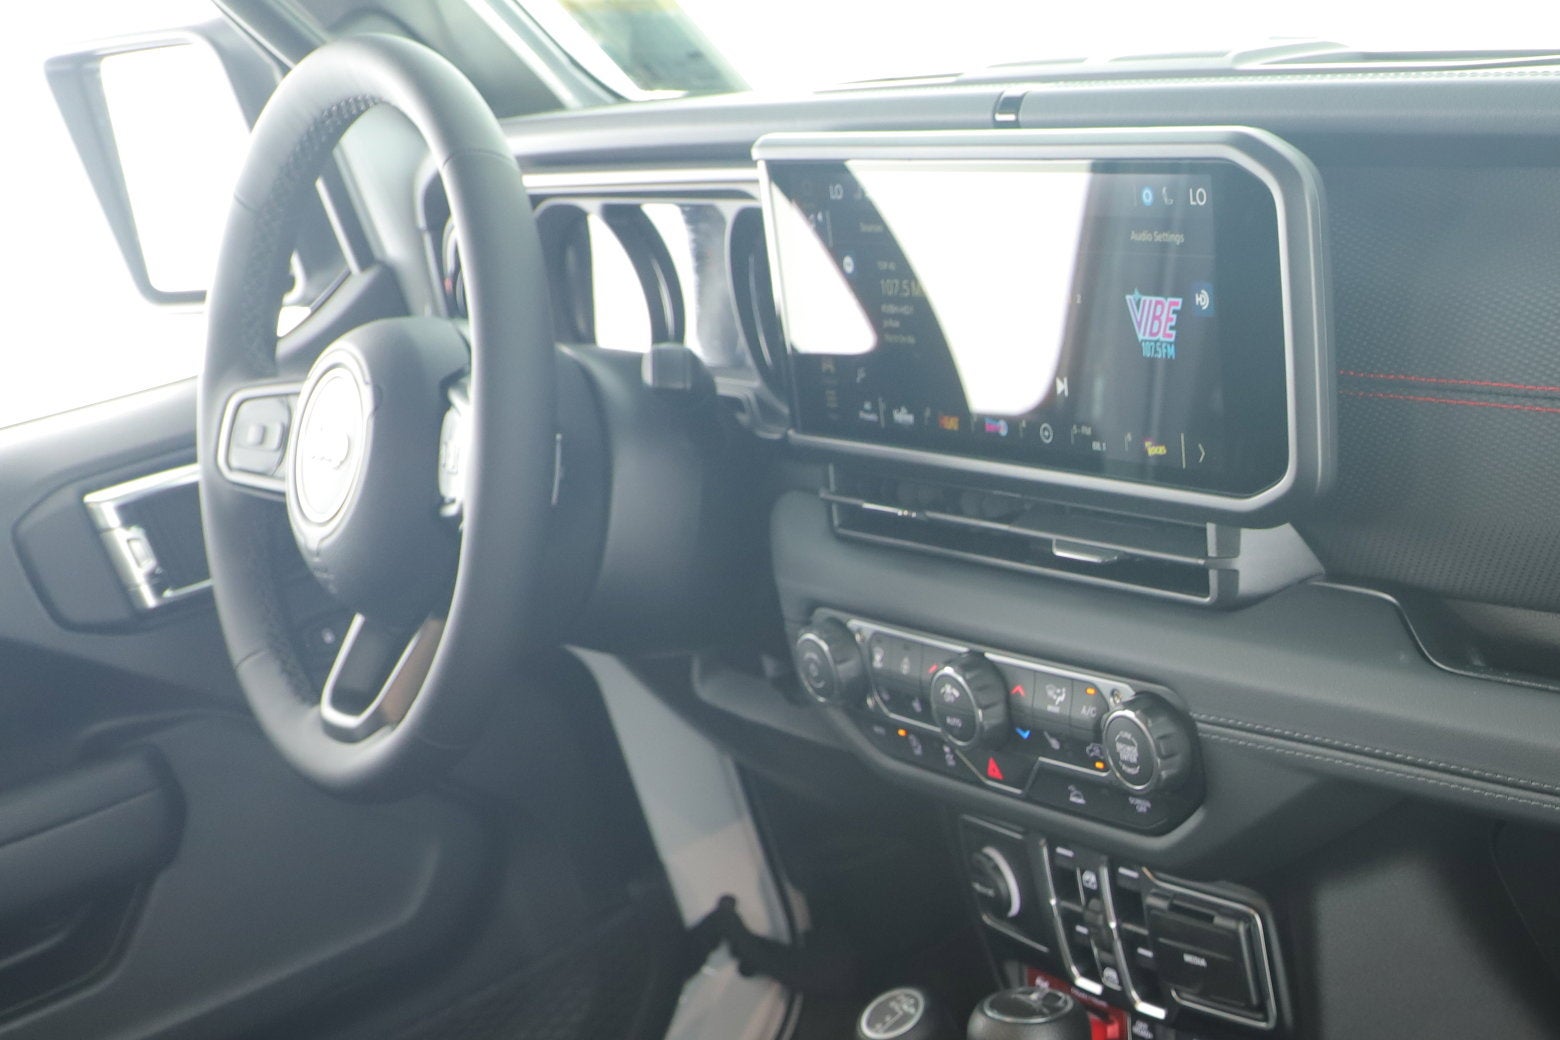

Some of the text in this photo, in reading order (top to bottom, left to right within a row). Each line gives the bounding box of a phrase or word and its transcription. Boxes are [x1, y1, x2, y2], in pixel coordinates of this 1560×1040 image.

[1189, 188, 1207, 205] LO
[1130, 230, 1185, 245] Audio Settings
[1125, 294, 1183, 343] VIBE
[1080, 704, 1098, 718] A/C
